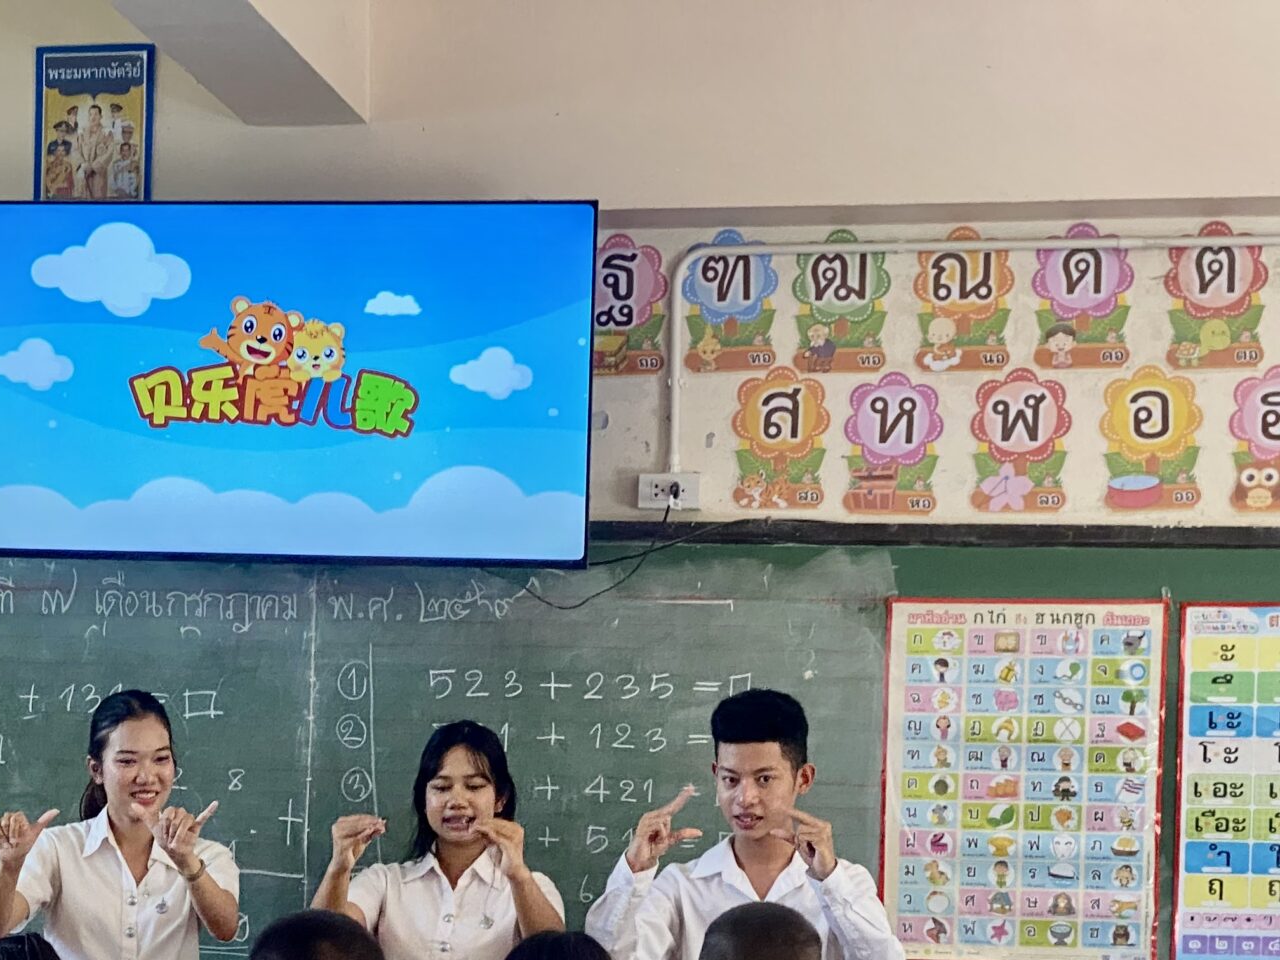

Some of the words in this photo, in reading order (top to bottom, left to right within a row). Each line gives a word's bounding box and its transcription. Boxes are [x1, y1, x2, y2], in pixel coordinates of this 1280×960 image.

[47, 60, 142, 82] พระมหากษัตริย์
[596, 252, 638, 327] ฐ
[931, 252, 992, 301] ณ
[1062, 248, 1102, 295] ด
[1195, 246, 1236, 295] ต
[129, 364, 418, 437] 贝乐虎儿歌
[761, 387, 802, 439] ส
[870, 396, 917, 444] ห
[992, 392, 1047, 442] ฬ
[1130, 390, 1170, 440] อ
[428, 668, 523, 699] 523
[583, 671, 676, 700] 235
[589, 722, 668, 752] 123
[584, 774, 654, 803] 421
